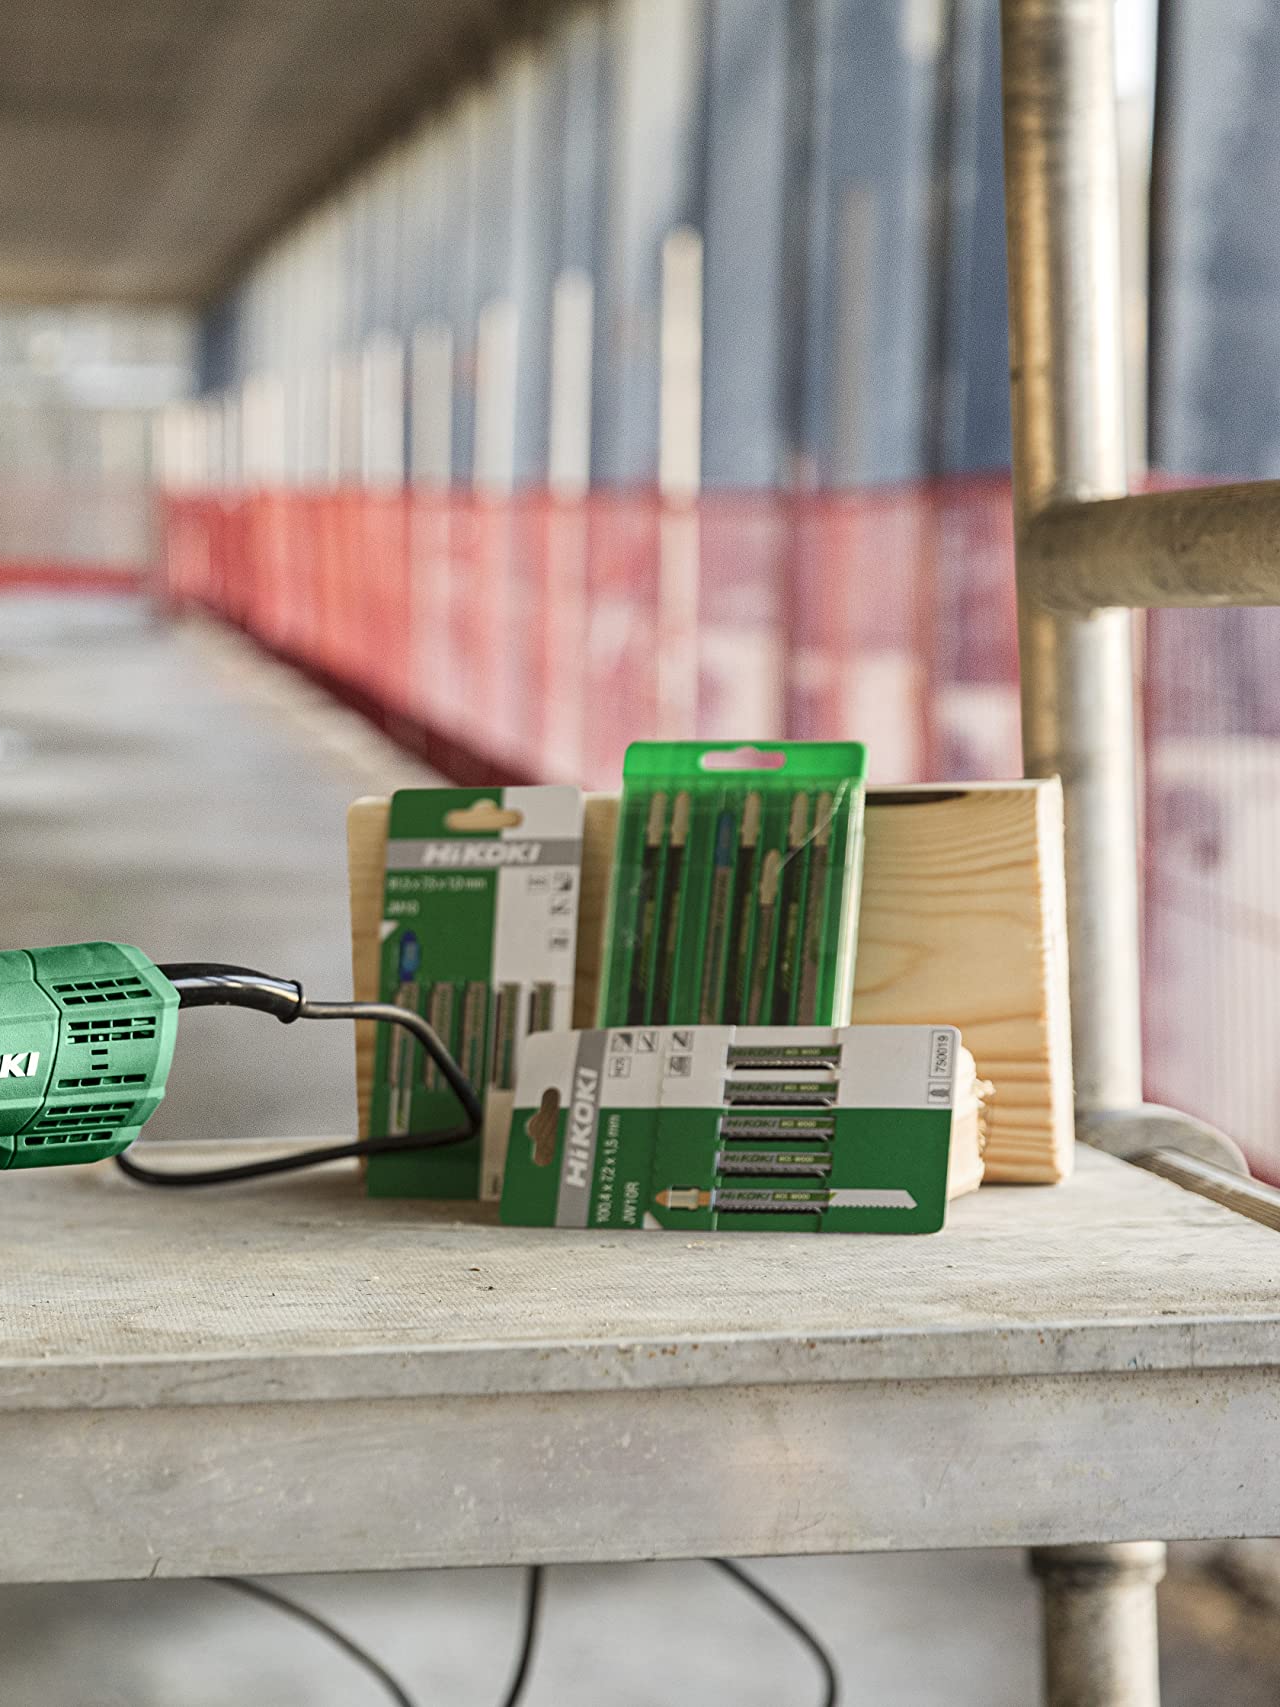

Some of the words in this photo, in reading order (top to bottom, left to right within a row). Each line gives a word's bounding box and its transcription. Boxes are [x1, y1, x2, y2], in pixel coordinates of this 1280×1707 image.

[421, 842, 543, 867] HiKOKI
[566, 1066, 598, 1188] HiKOKI
[596, 1193, 613, 1224] 100,4
[607, 1114, 621, 1138] mm
[622, 1181, 640, 1225] JW10R
